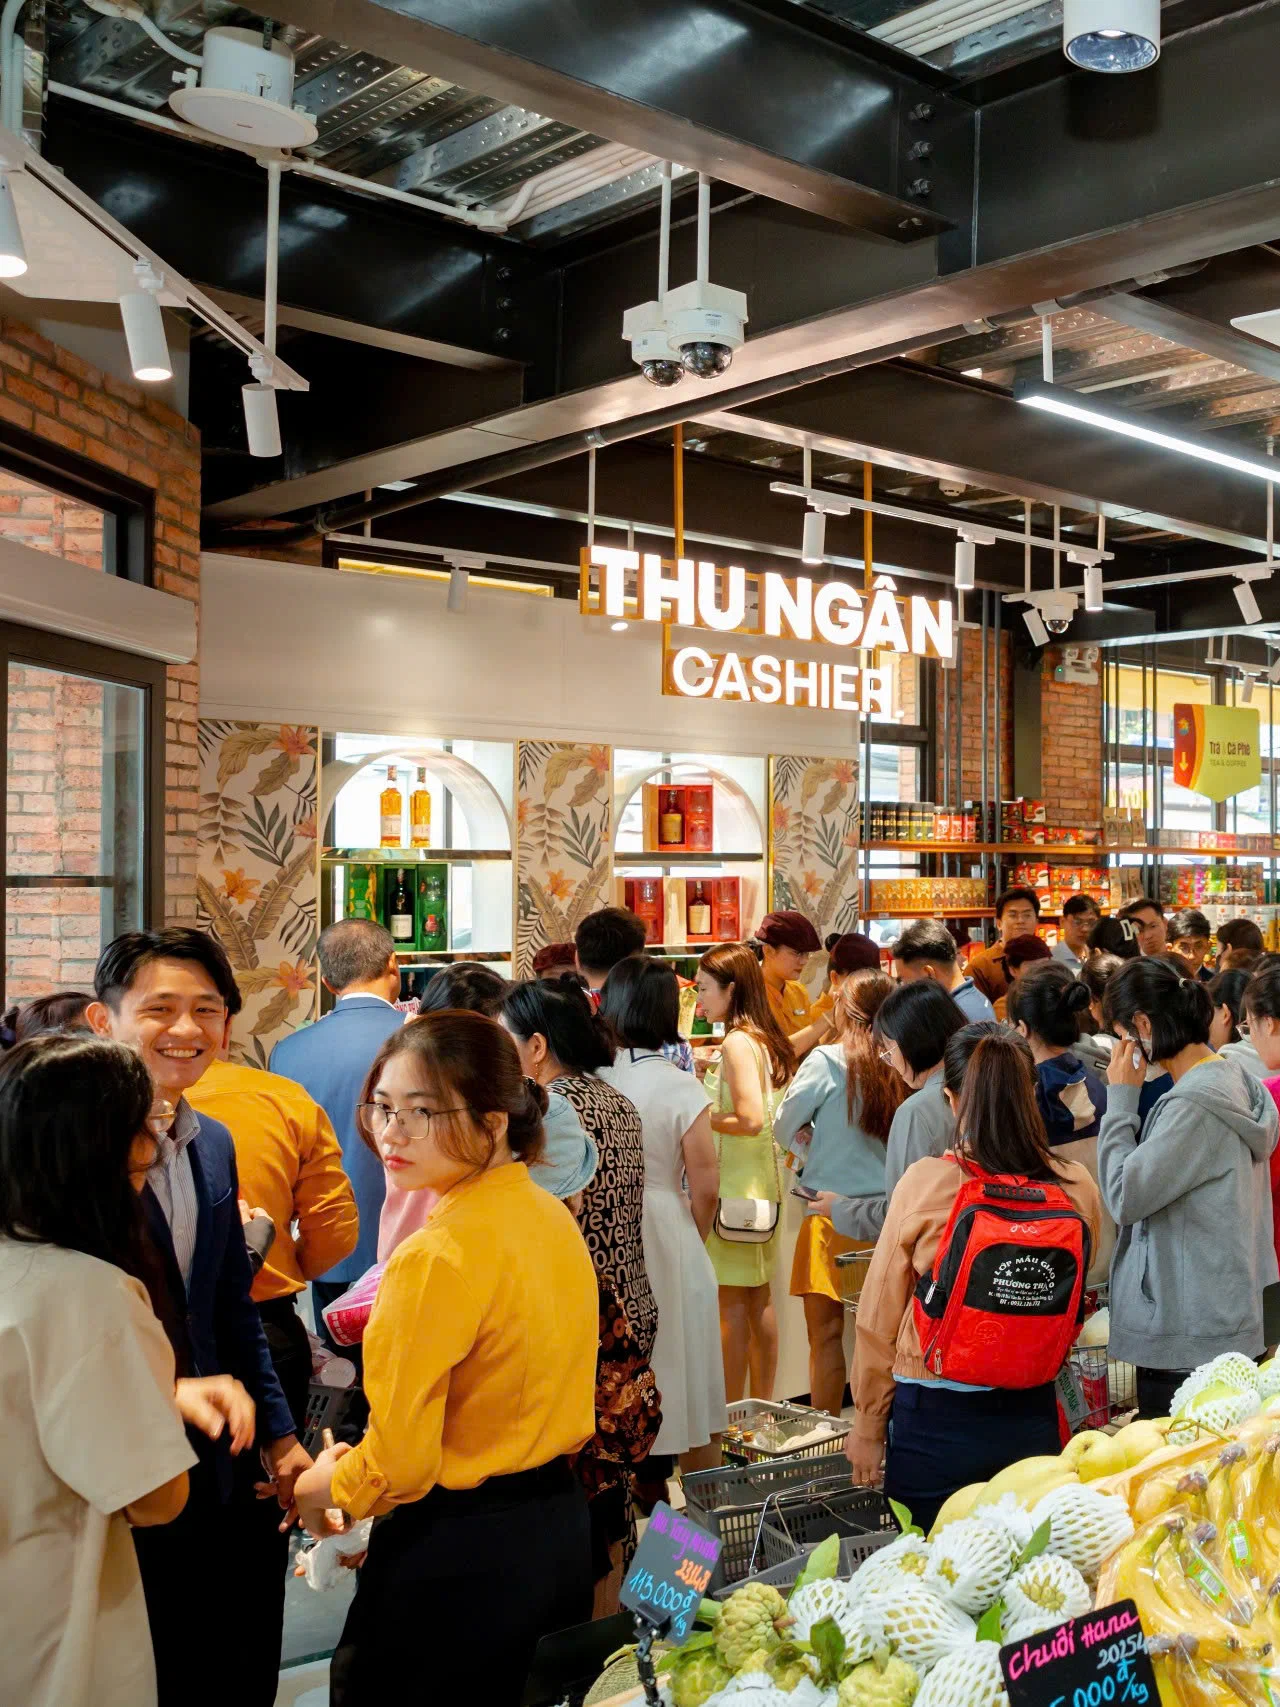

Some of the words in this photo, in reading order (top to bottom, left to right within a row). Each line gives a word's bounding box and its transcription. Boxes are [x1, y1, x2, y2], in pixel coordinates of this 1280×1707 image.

[590, 545, 745, 631] THU
[765, 575, 952, 657] NGÂN
[672, 646, 891, 713] CASHIER
[993, 1278, 1031, 1289] PHƯƠNG
[994, 1260, 1012, 1276] LỚP
